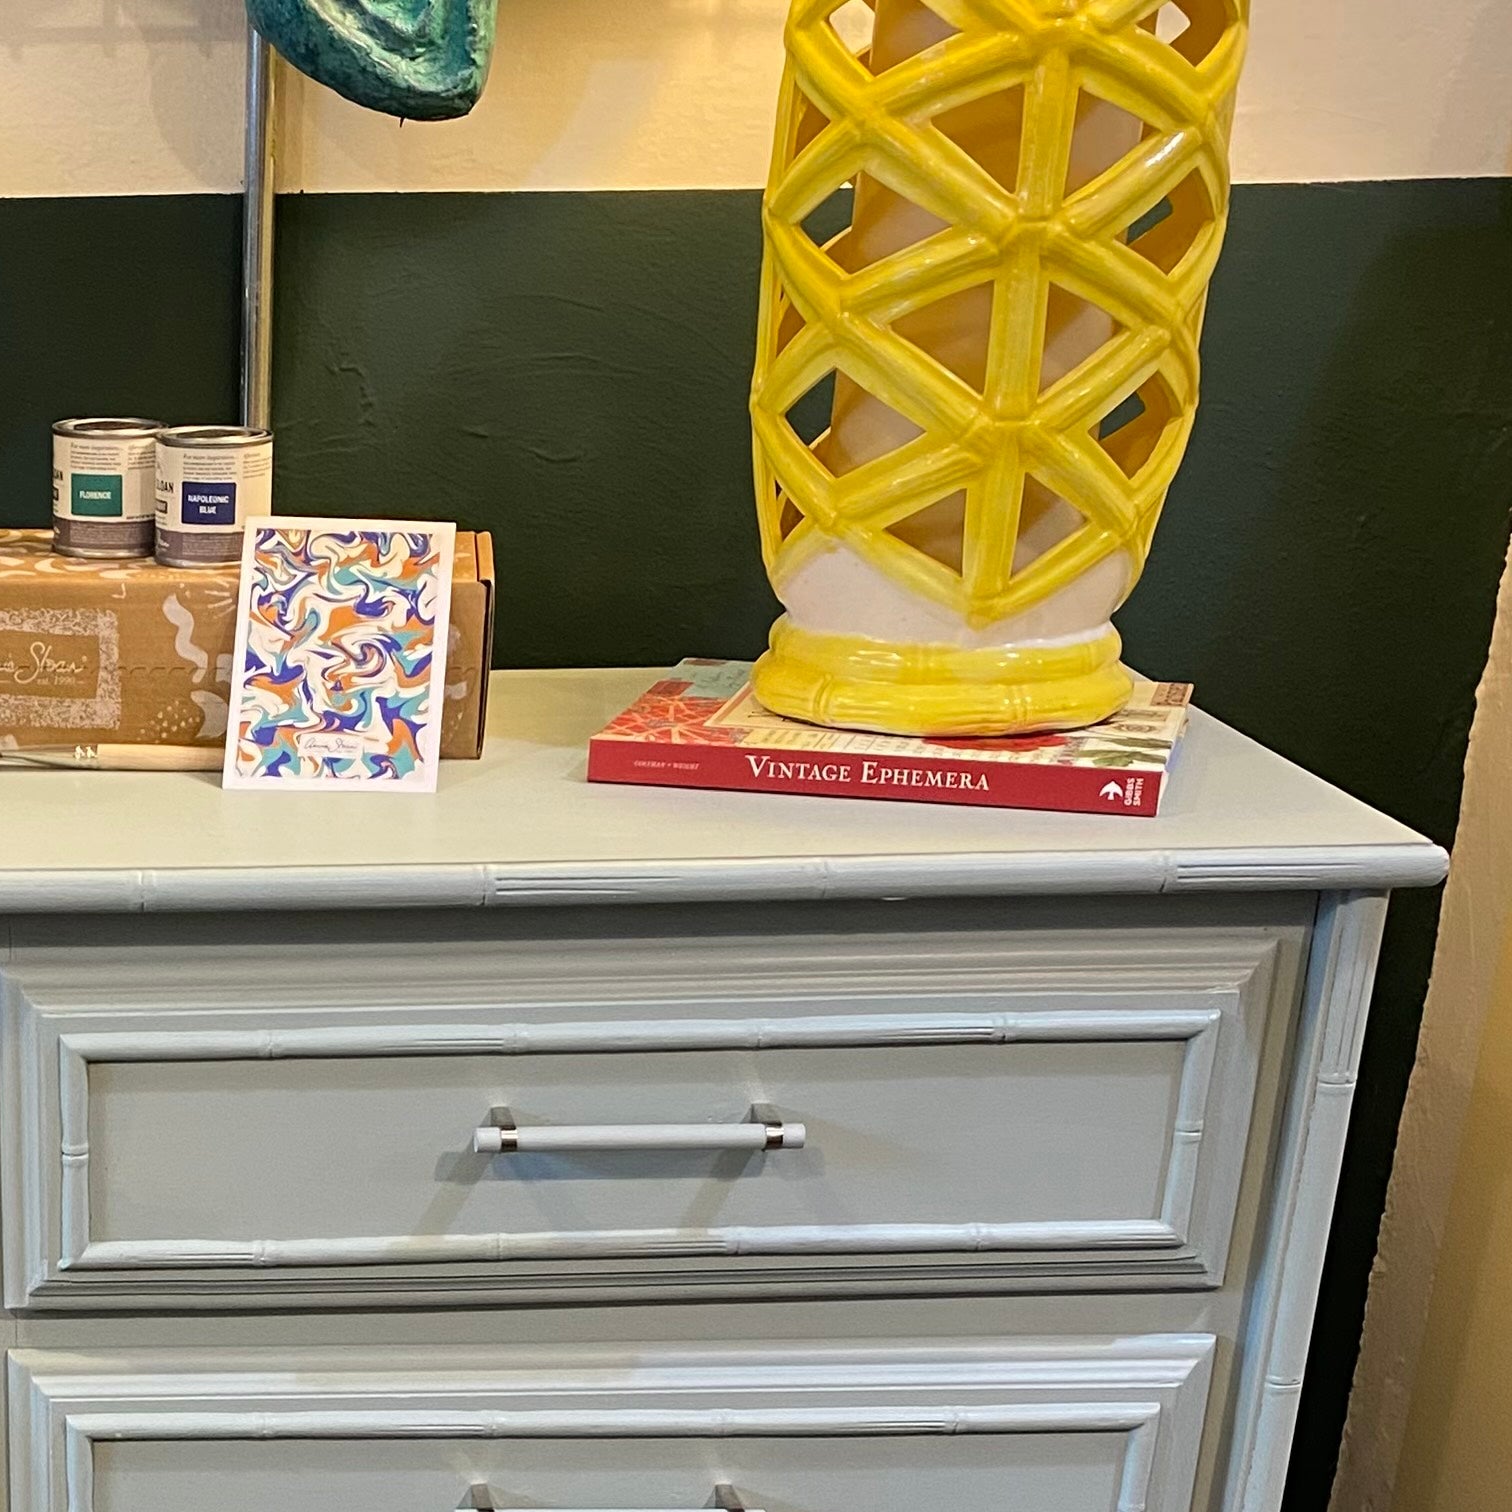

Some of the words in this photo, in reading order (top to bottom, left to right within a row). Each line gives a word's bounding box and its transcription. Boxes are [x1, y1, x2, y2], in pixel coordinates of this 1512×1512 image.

[79, 490, 112, 500] FLORENCE
[187, 494, 230, 504] NAPOLEONIC
[199, 505, 217, 514] BLUE
[745, 755, 851, 783] VINTAGE
[861, 760, 990, 791] EPHEMERA
[1123, 777, 1136, 806] GIBBS
[1133, 777, 1145, 807] SMITH
